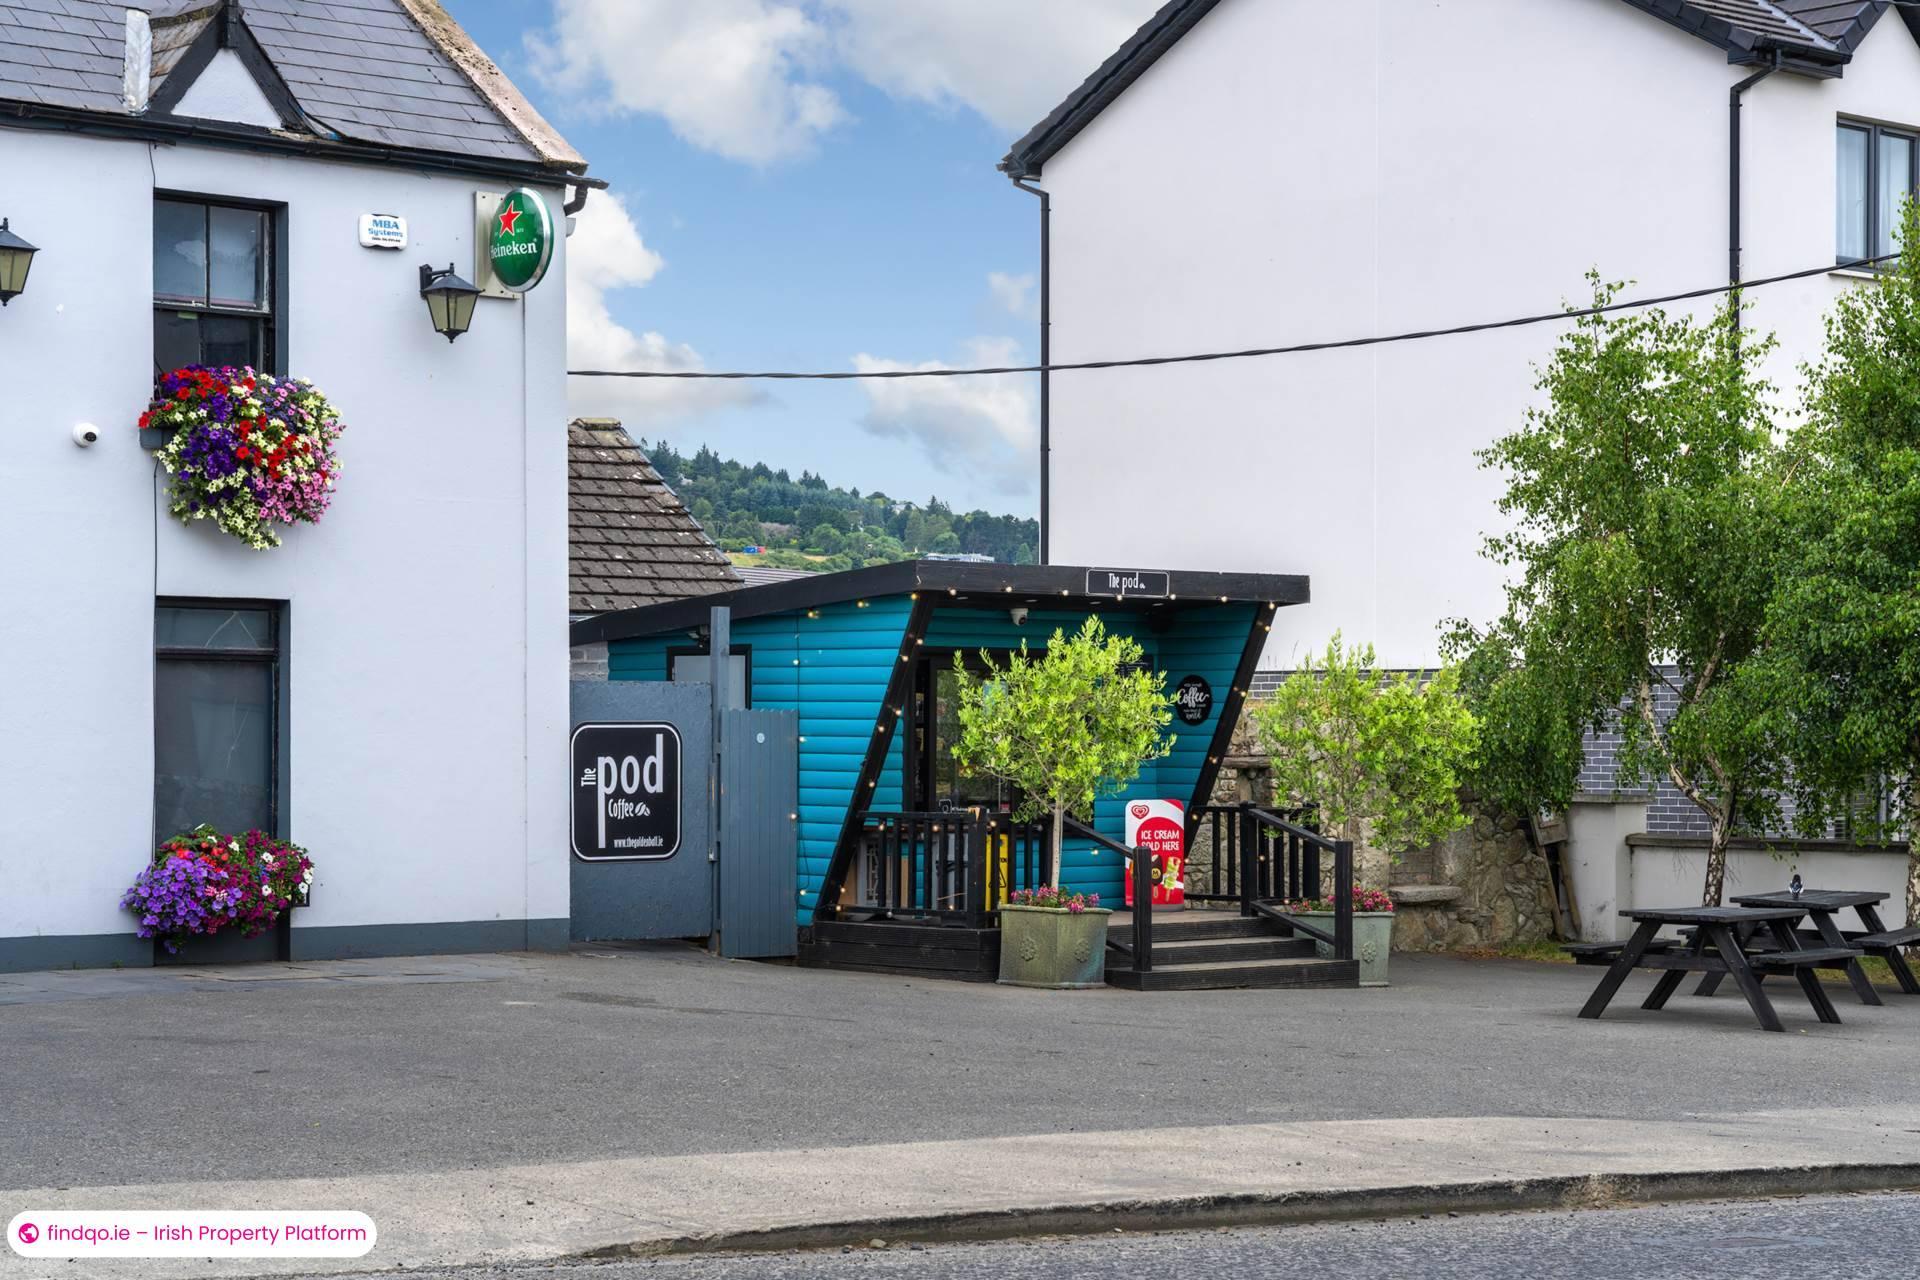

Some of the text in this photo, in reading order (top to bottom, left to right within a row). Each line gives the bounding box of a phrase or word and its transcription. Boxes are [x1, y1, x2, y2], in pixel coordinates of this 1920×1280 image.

[368, 228, 403, 238] Systems
[372, 219, 399, 230] MBA
[1108, 571, 1139, 595] The pod
[1177, 687, 1209, 708] Coffee
[581, 768, 596, 787] The
[597, 733, 664, 849] pod
[608, 798, 634, 820] Coffee
[1141, 829, 1180, 840] ICE CREAM
[1162, 842, 1180, 851] HERE
